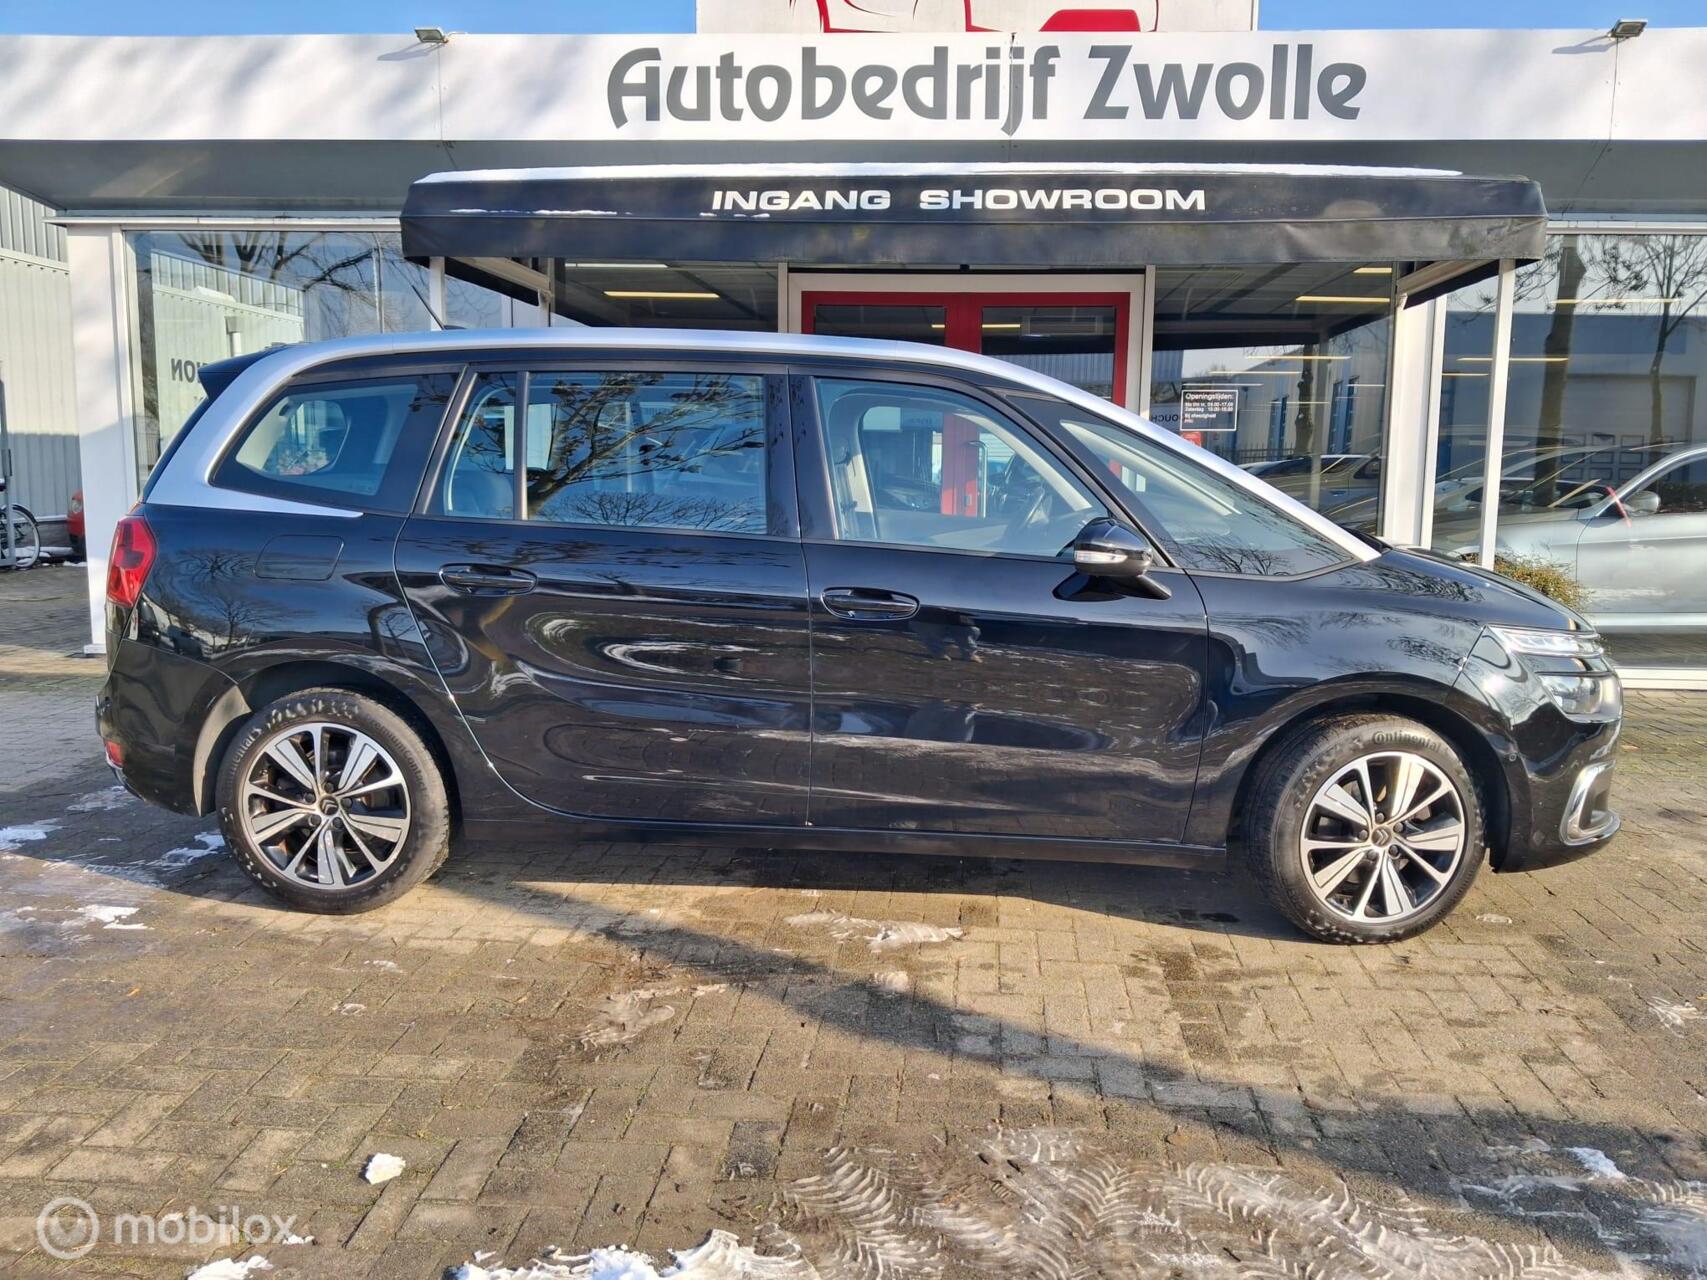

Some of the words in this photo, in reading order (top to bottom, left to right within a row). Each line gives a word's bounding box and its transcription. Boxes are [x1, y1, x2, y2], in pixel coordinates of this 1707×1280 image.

[607, 45, 1061, 136] Autobedrijf
[1083, 44, 1367, 120] Zwolle
[712, 190, 891, 210] INGANG
[919, 189, 1206, 210] SHOWROOM
[1372, 730, 1441, 755] Continental
